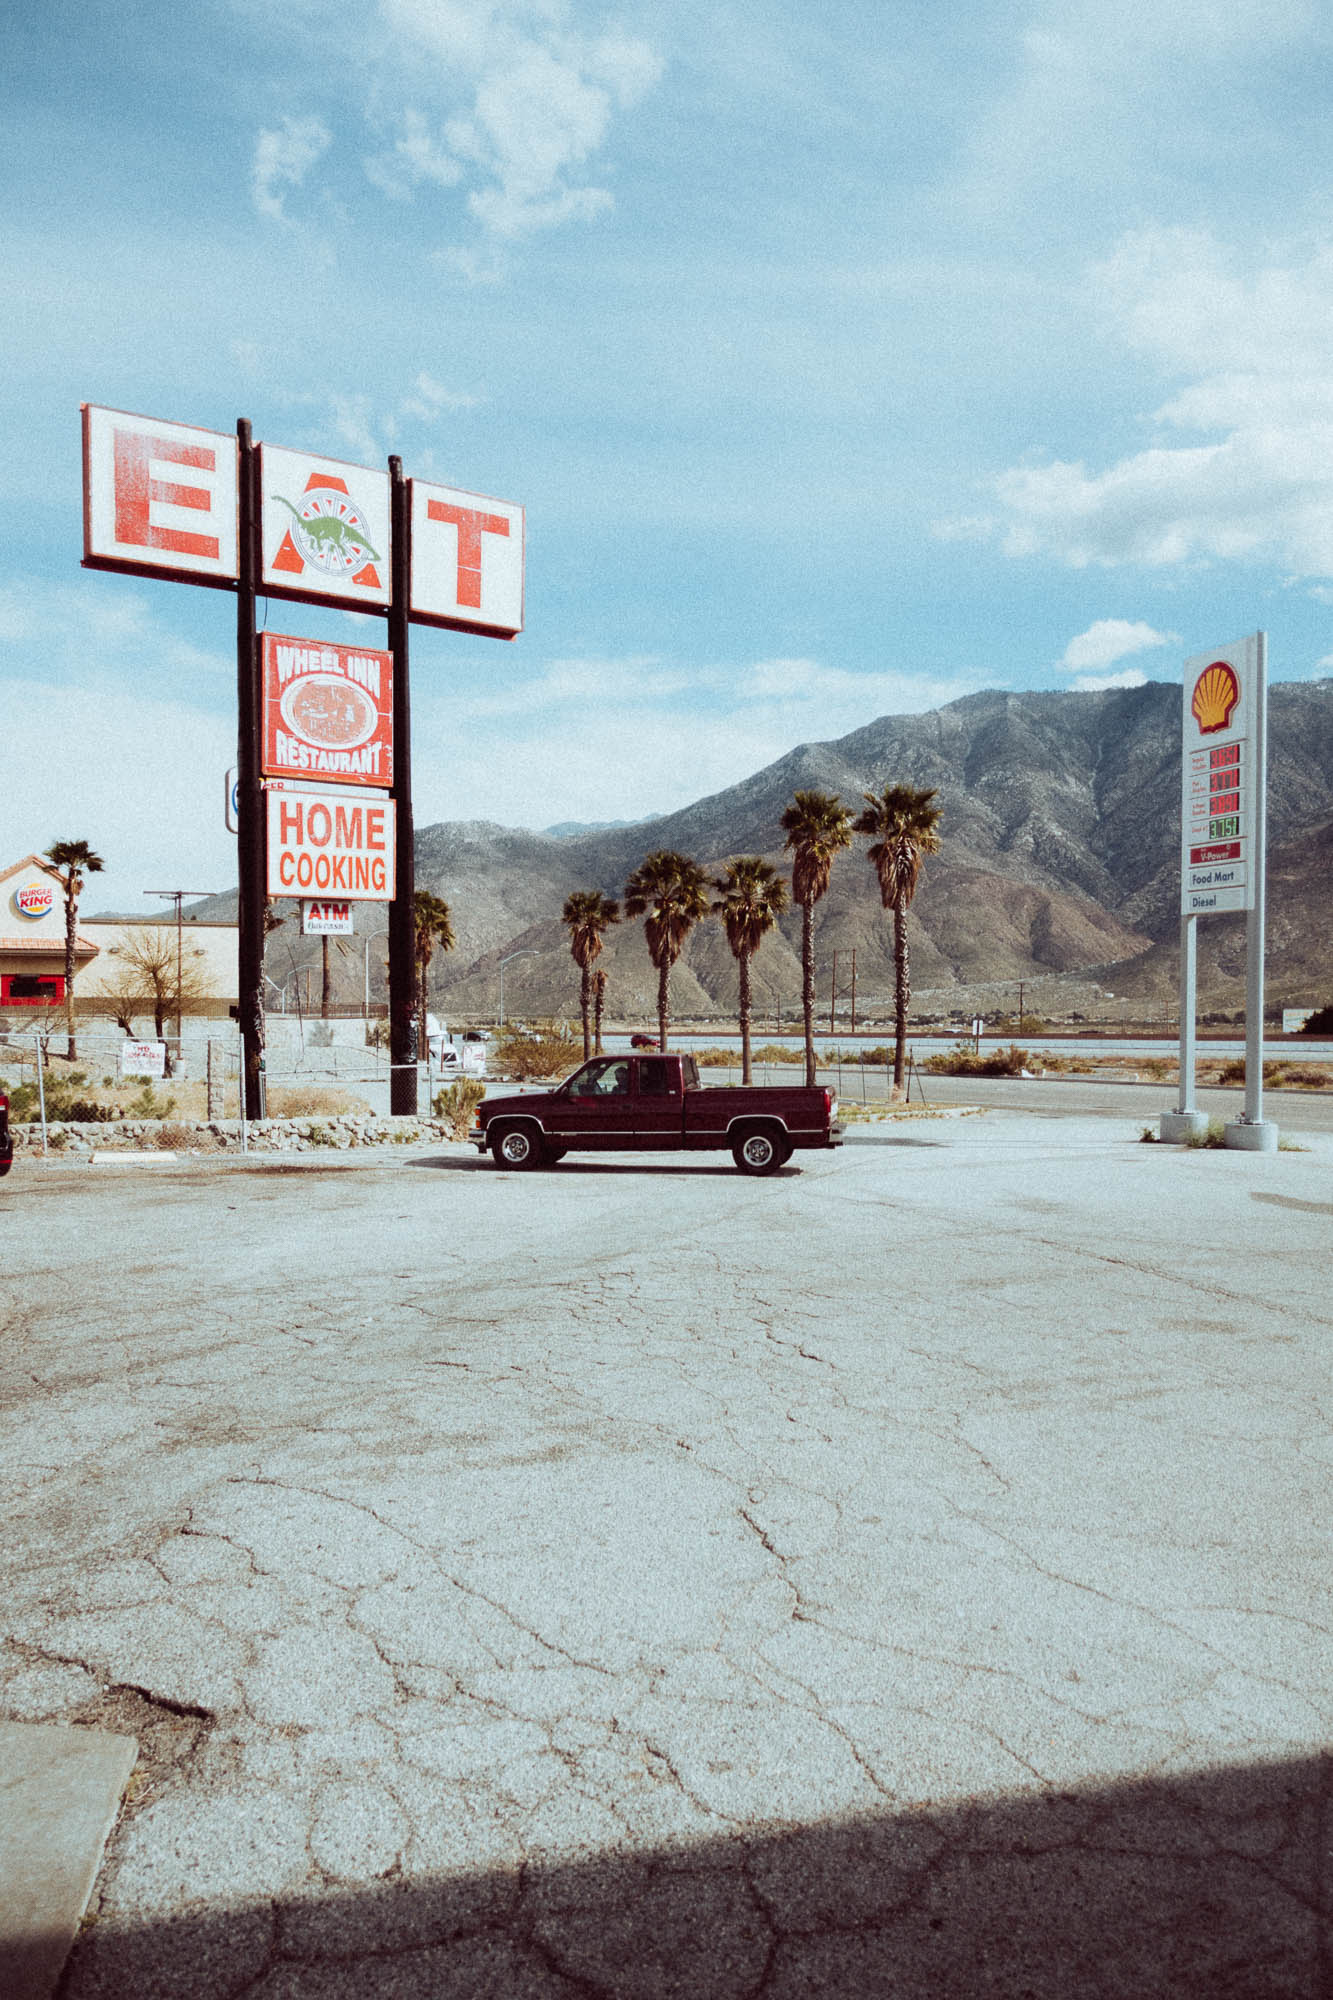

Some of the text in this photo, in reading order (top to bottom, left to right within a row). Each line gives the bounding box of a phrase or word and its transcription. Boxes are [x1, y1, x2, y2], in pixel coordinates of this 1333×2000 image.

[114, 427, 510, 609] EAT
[276, 645, 381, 699] WHEEL INN
[276, 729, 383, 775] RESTAURANT
[280, 801, 385, 851] HOME
[280, 851, 386, 891] COOKING
[1192, 871, 1234, 885] Food Mart
[20, 896, 53, 907] KING
[308, 903, 349, 920] ATM
[1192, 895, 1216, 907] Diesel
